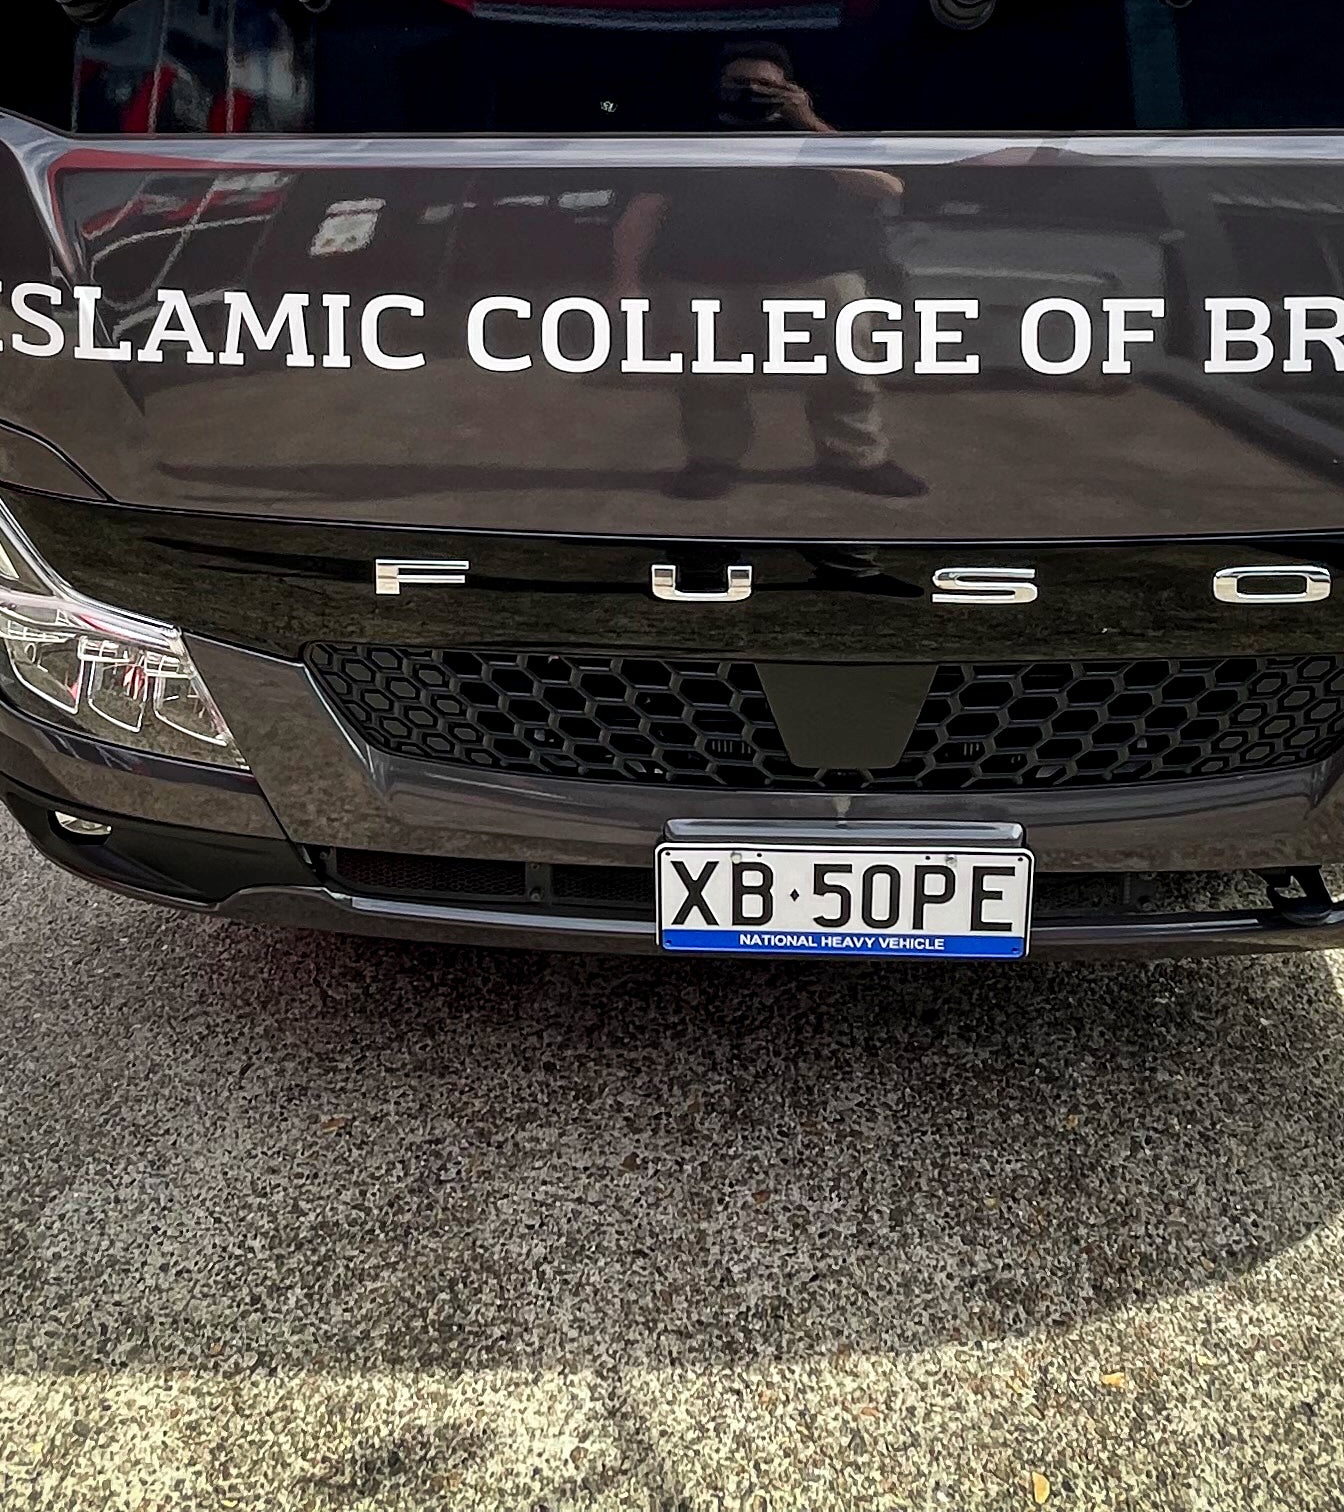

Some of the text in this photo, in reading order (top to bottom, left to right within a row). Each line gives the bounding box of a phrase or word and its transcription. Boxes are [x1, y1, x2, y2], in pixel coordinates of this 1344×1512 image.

[466, 296, 981, 375] COLLEGE
[1020, 296, 1165, 375] OF
[375, 558, 1332, 604] FUSO
[739, 933, 946, 950] NATIONAL HEAVY VEHICLE
